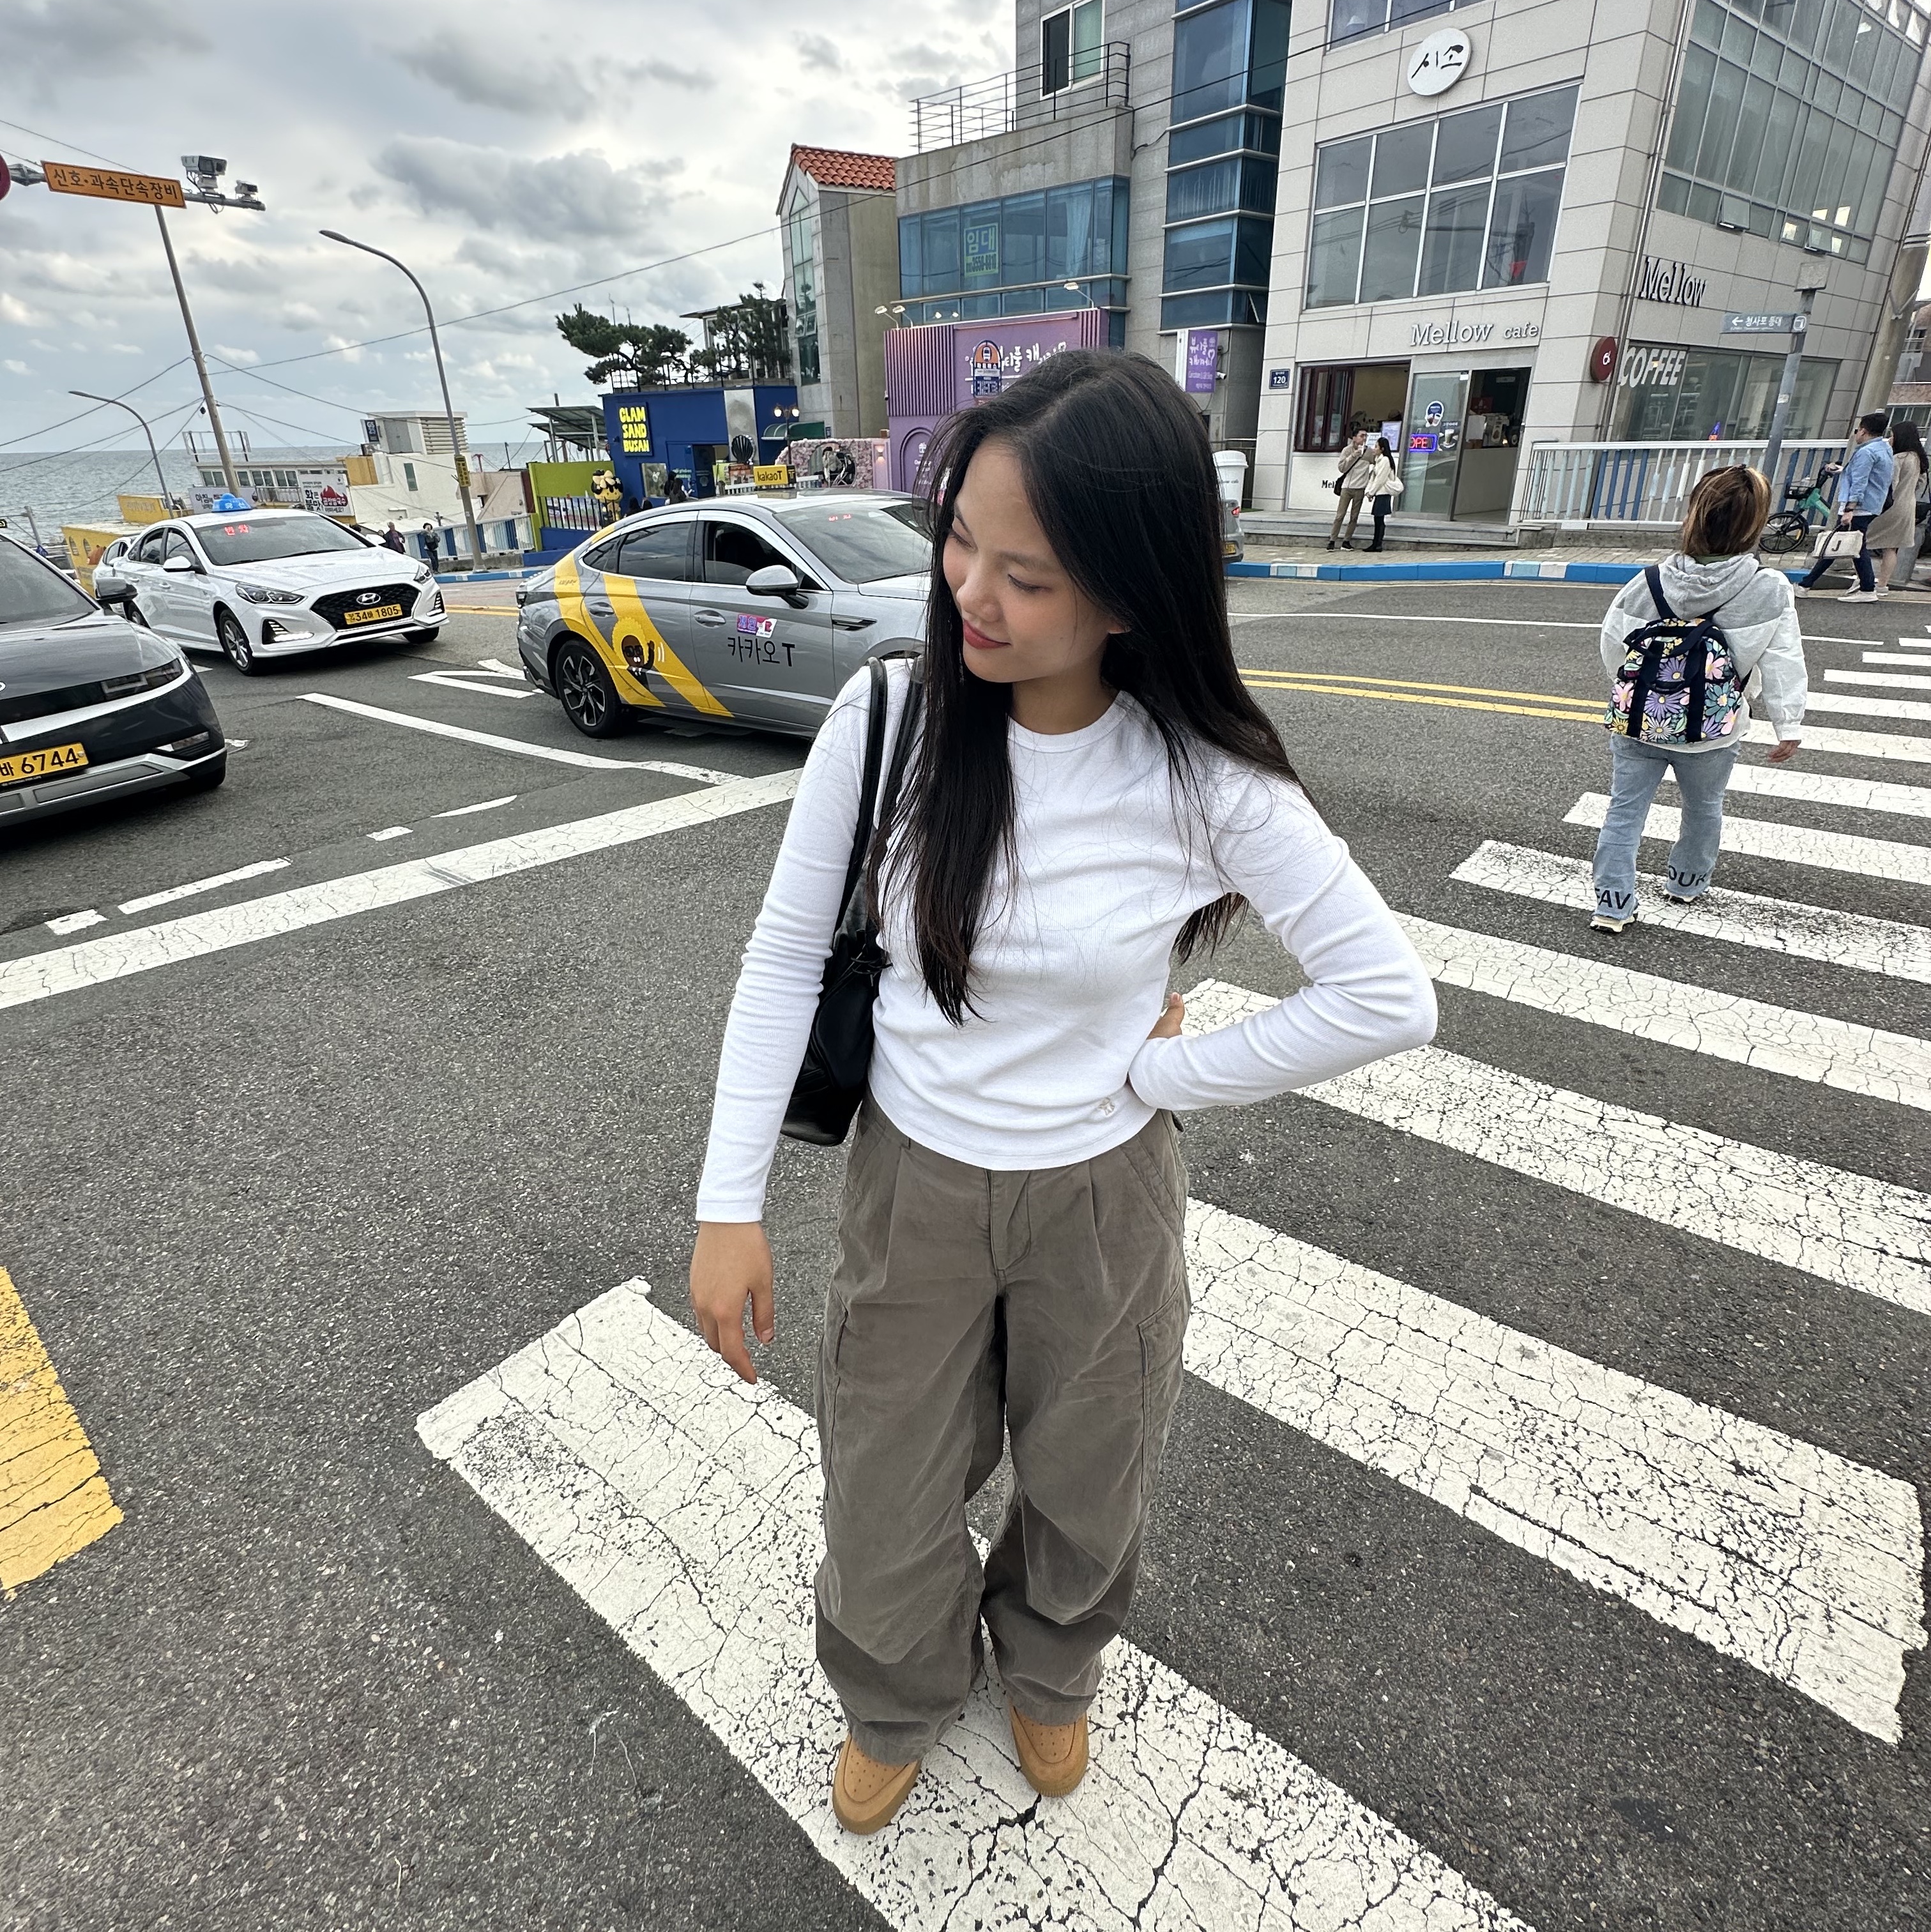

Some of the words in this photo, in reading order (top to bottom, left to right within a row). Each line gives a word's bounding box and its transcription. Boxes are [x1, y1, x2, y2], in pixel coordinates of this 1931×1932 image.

[1411, 45, 1463, 79] 시소
[966, 227, 995, 254] 임대
[1639, 256, 1707, 307] Mellow
[1745, 316, 1767, 326] 청사포
[1410, 321, 1494, 346] Mellow
[1504, 322, 1539, 338] cafe
[1619, 347, 1686, 388] COFFEE
[1273, 376, 1286, 384] 120
[622, 423, 647, 439] SAND
[623, 439, 650, 453] BUSAN
[1831, 540, 1842, 551] J
[376, 606, 399, 618] 1805
[21, 748, 79, 774] 6744
